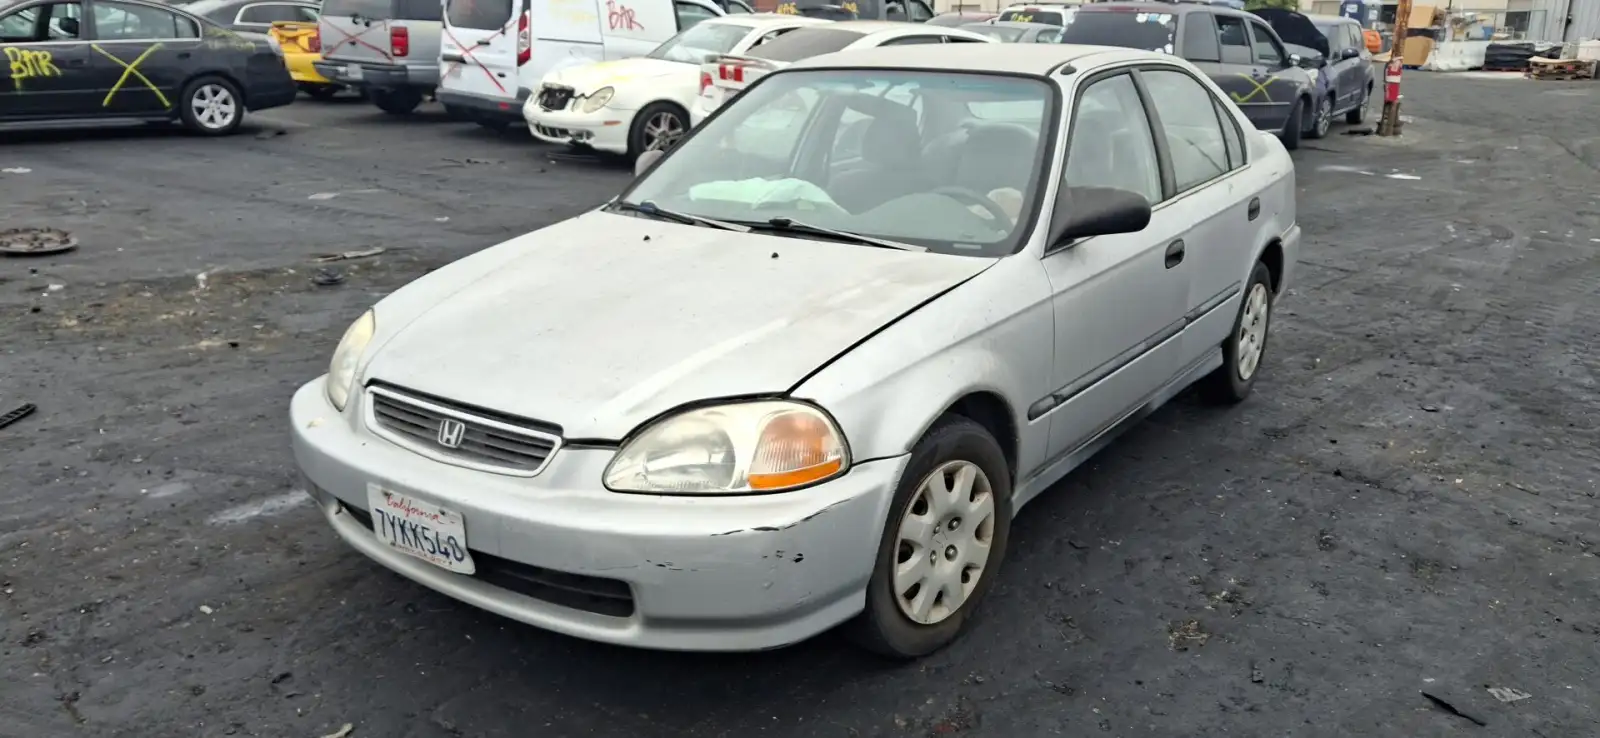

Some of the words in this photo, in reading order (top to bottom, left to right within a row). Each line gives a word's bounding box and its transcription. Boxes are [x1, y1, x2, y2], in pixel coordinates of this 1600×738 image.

[605, 0, 645, 31] BAR
[3, 46, 62, 79] BAR
[374, 508, 465, 562] 7YKK540
